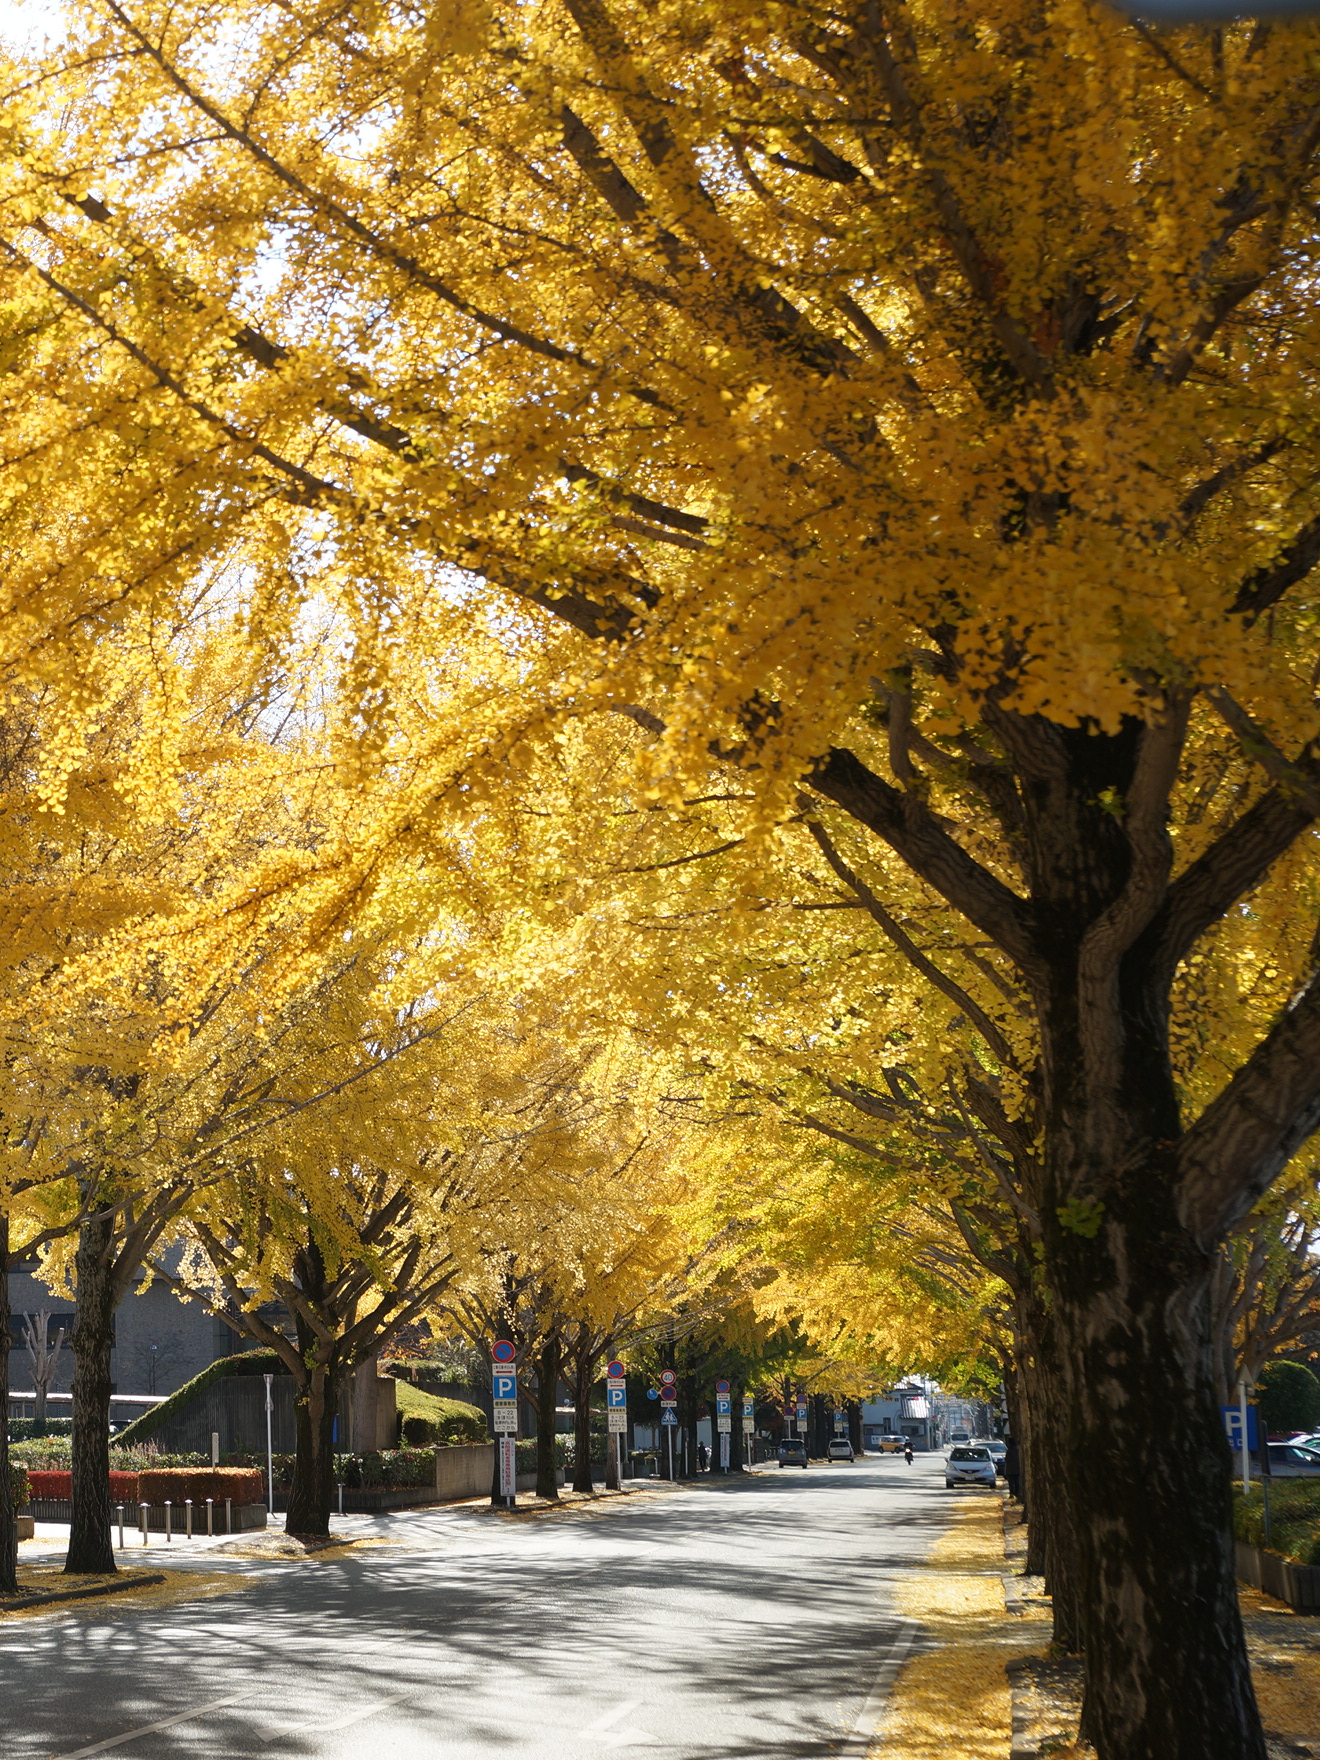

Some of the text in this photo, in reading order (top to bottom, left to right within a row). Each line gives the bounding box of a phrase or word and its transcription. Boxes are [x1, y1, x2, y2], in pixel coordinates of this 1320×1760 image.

[498, 1378, 512, 1397] P
[612, 1390, 623, 1406] P
[720, 1401, 728, 1413] P
[744, 1405, 751, 1415] P
[799, 1409, 805, 1418] P
